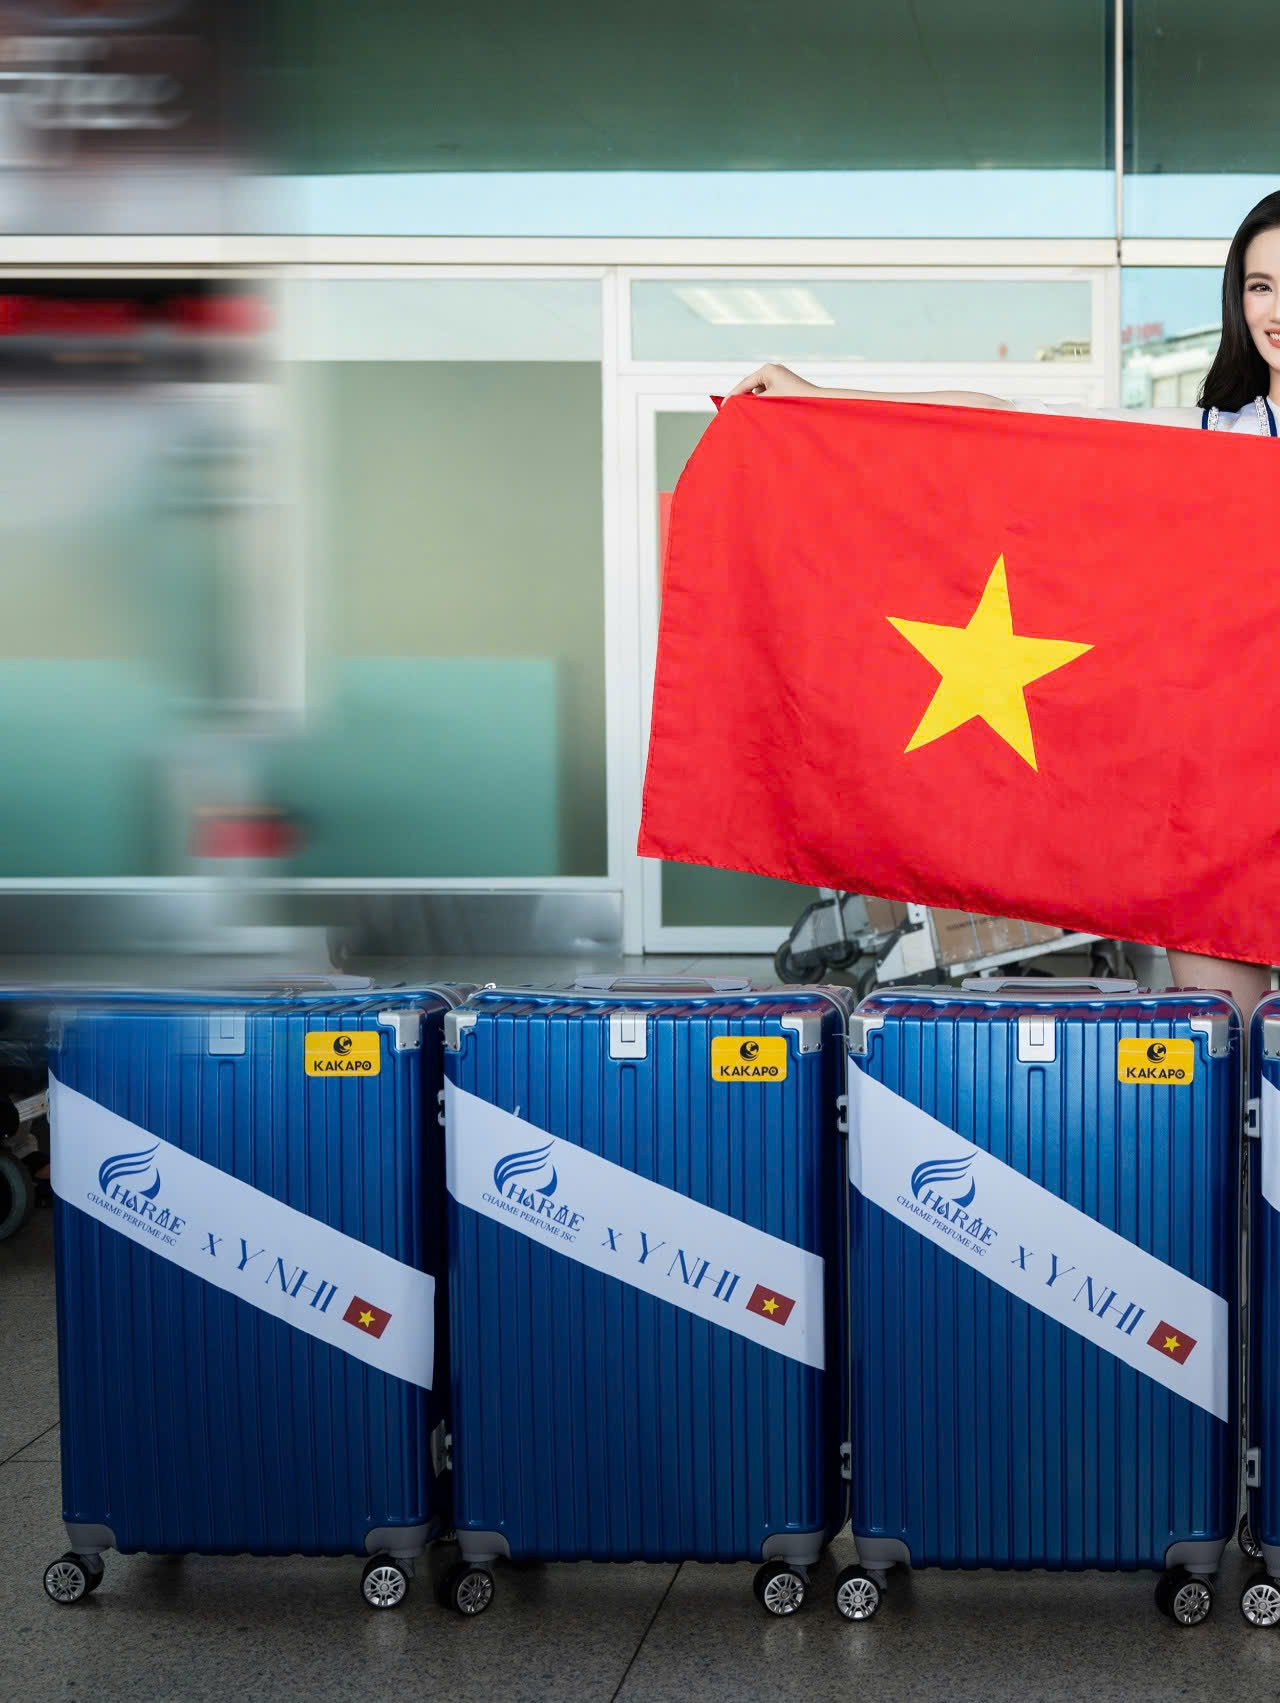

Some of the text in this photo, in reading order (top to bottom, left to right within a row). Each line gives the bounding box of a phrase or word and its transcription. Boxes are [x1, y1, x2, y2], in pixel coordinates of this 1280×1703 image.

[313, 1060, 372, 1072] KAKAPO
[720, 1065, 779, 1077] KAKAPO
[1126, 1067, 1186, 1080] KAKAPO
[87, 1192, 177, 1246] CHARME PERFUME JSC
[482, 1192, 577, 1243] CHARME PERFUME JSC
[896, 1195, 987, 1257] CHARME PERFUME JSC
[265, 1257, 338, 1313] NHI
[667, 1249, 742, 1303] NHI
[1072, 1276, 1147, 1336] NHI
